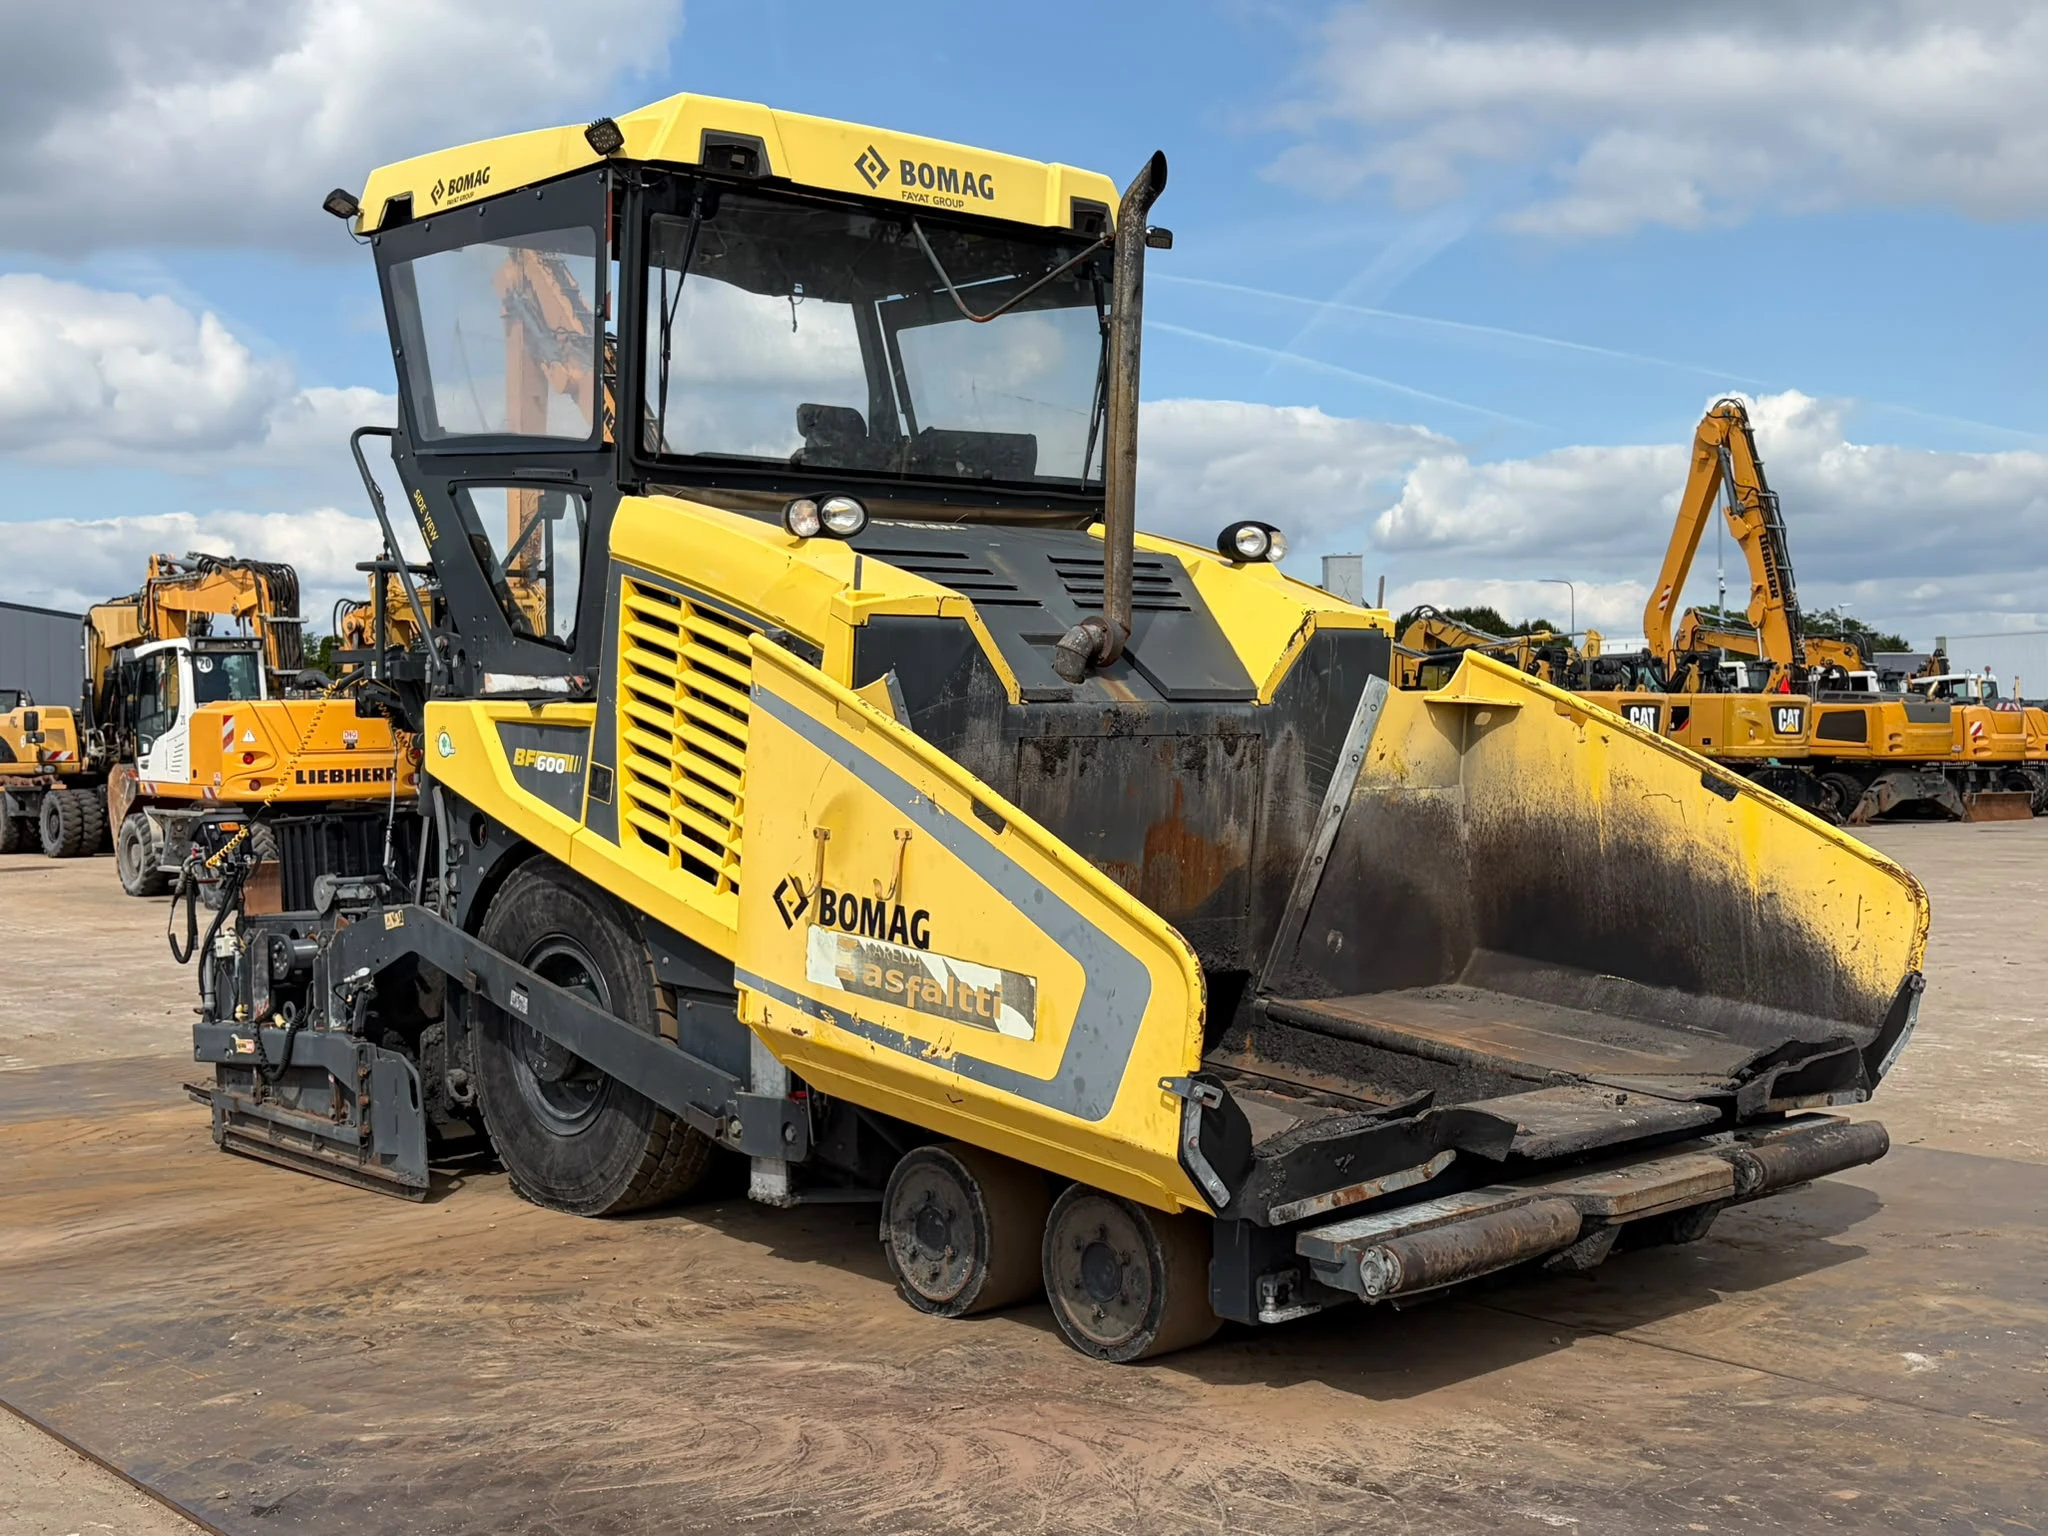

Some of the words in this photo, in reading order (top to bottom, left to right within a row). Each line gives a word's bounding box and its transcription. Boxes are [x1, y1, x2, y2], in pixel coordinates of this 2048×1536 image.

[448, 166, 490, 197] BOMAG
[900, 159, 994, 200] BOMAG
[902, 190, 930, 204] FAYAT
[933, 195, 964, 209] GROUP
[413, 489, 427, 514] SIDE
[424, 511, 439, 541] VIEW
[1758, 533, 1780, 600] LIEBHERR
[200, 658, 211, 669] 20
[1778, 708, 1800, 733] CAT
[819, 887, 931, 950] BOMAG
[863, 962, 1003, 1020] asfaltti
